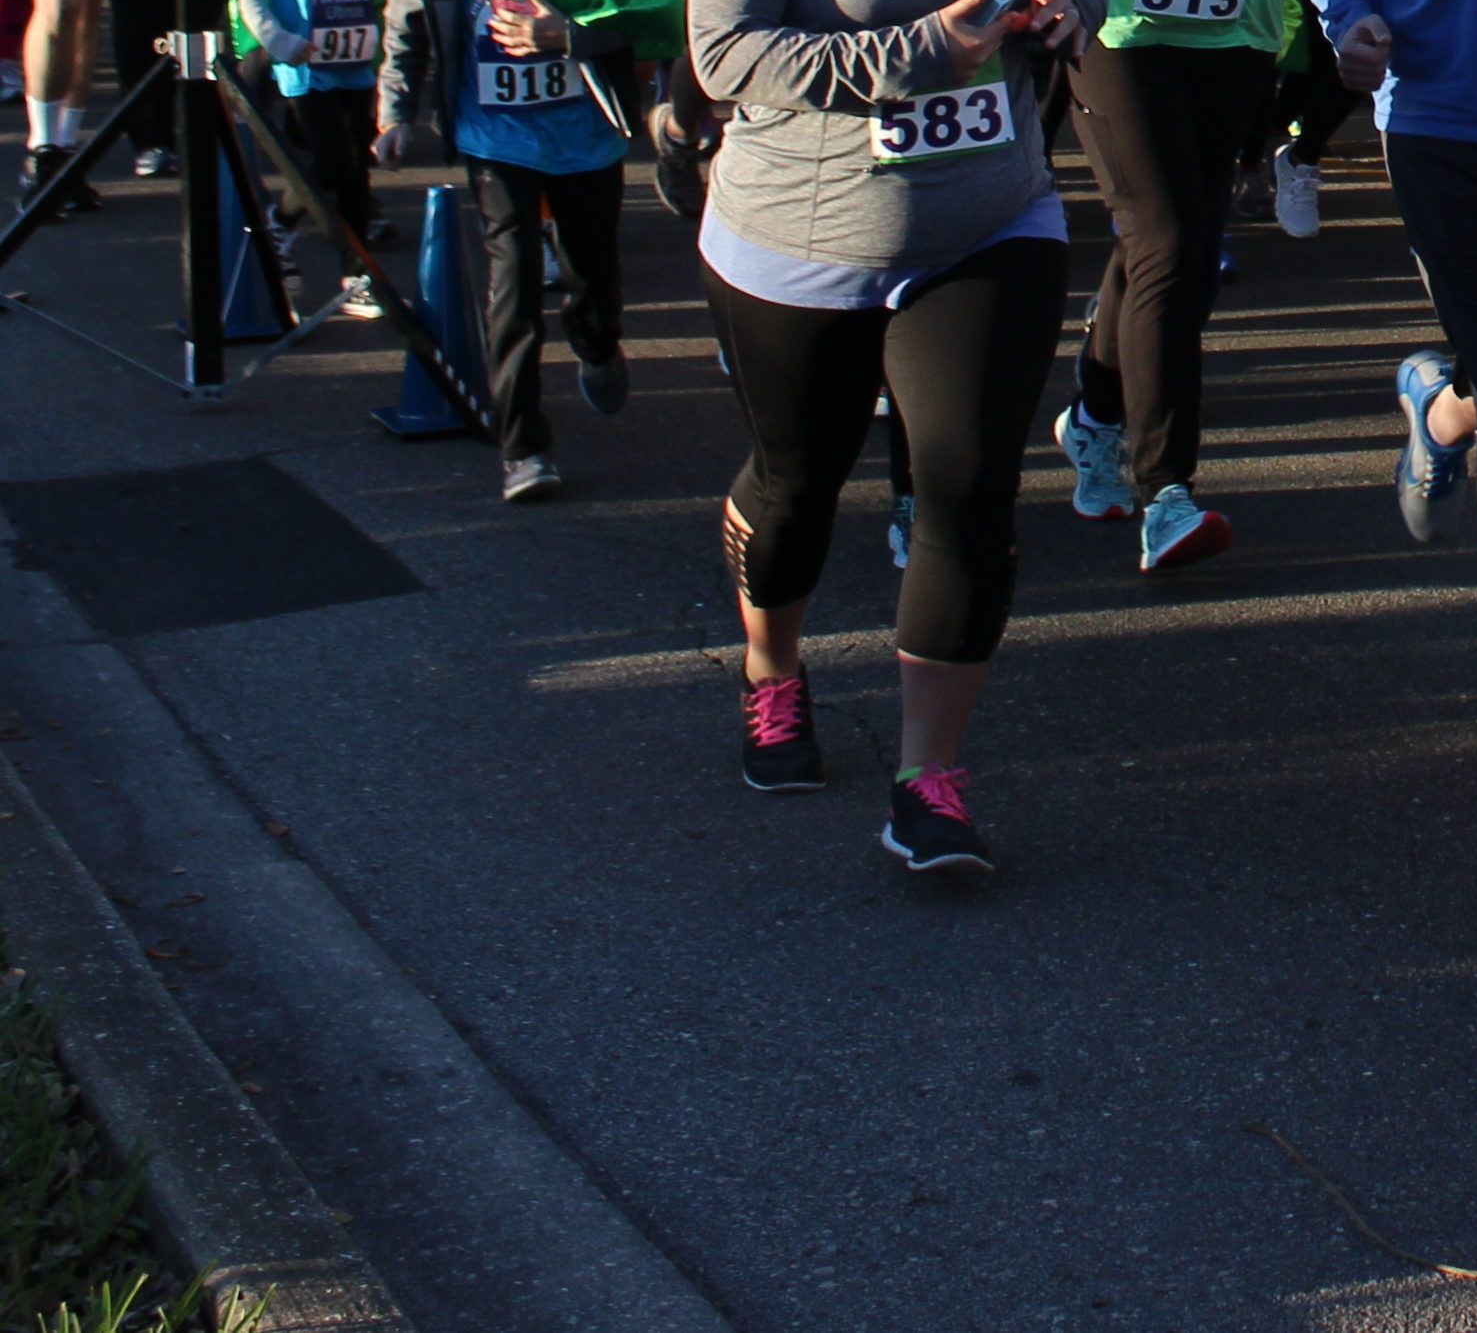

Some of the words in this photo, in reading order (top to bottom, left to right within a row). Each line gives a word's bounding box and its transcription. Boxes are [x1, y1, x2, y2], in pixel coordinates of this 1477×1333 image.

[321, 28, 367, 61] 917
[495, 61, 568, 103] 918
[879, 89, 1003, 154] 583
